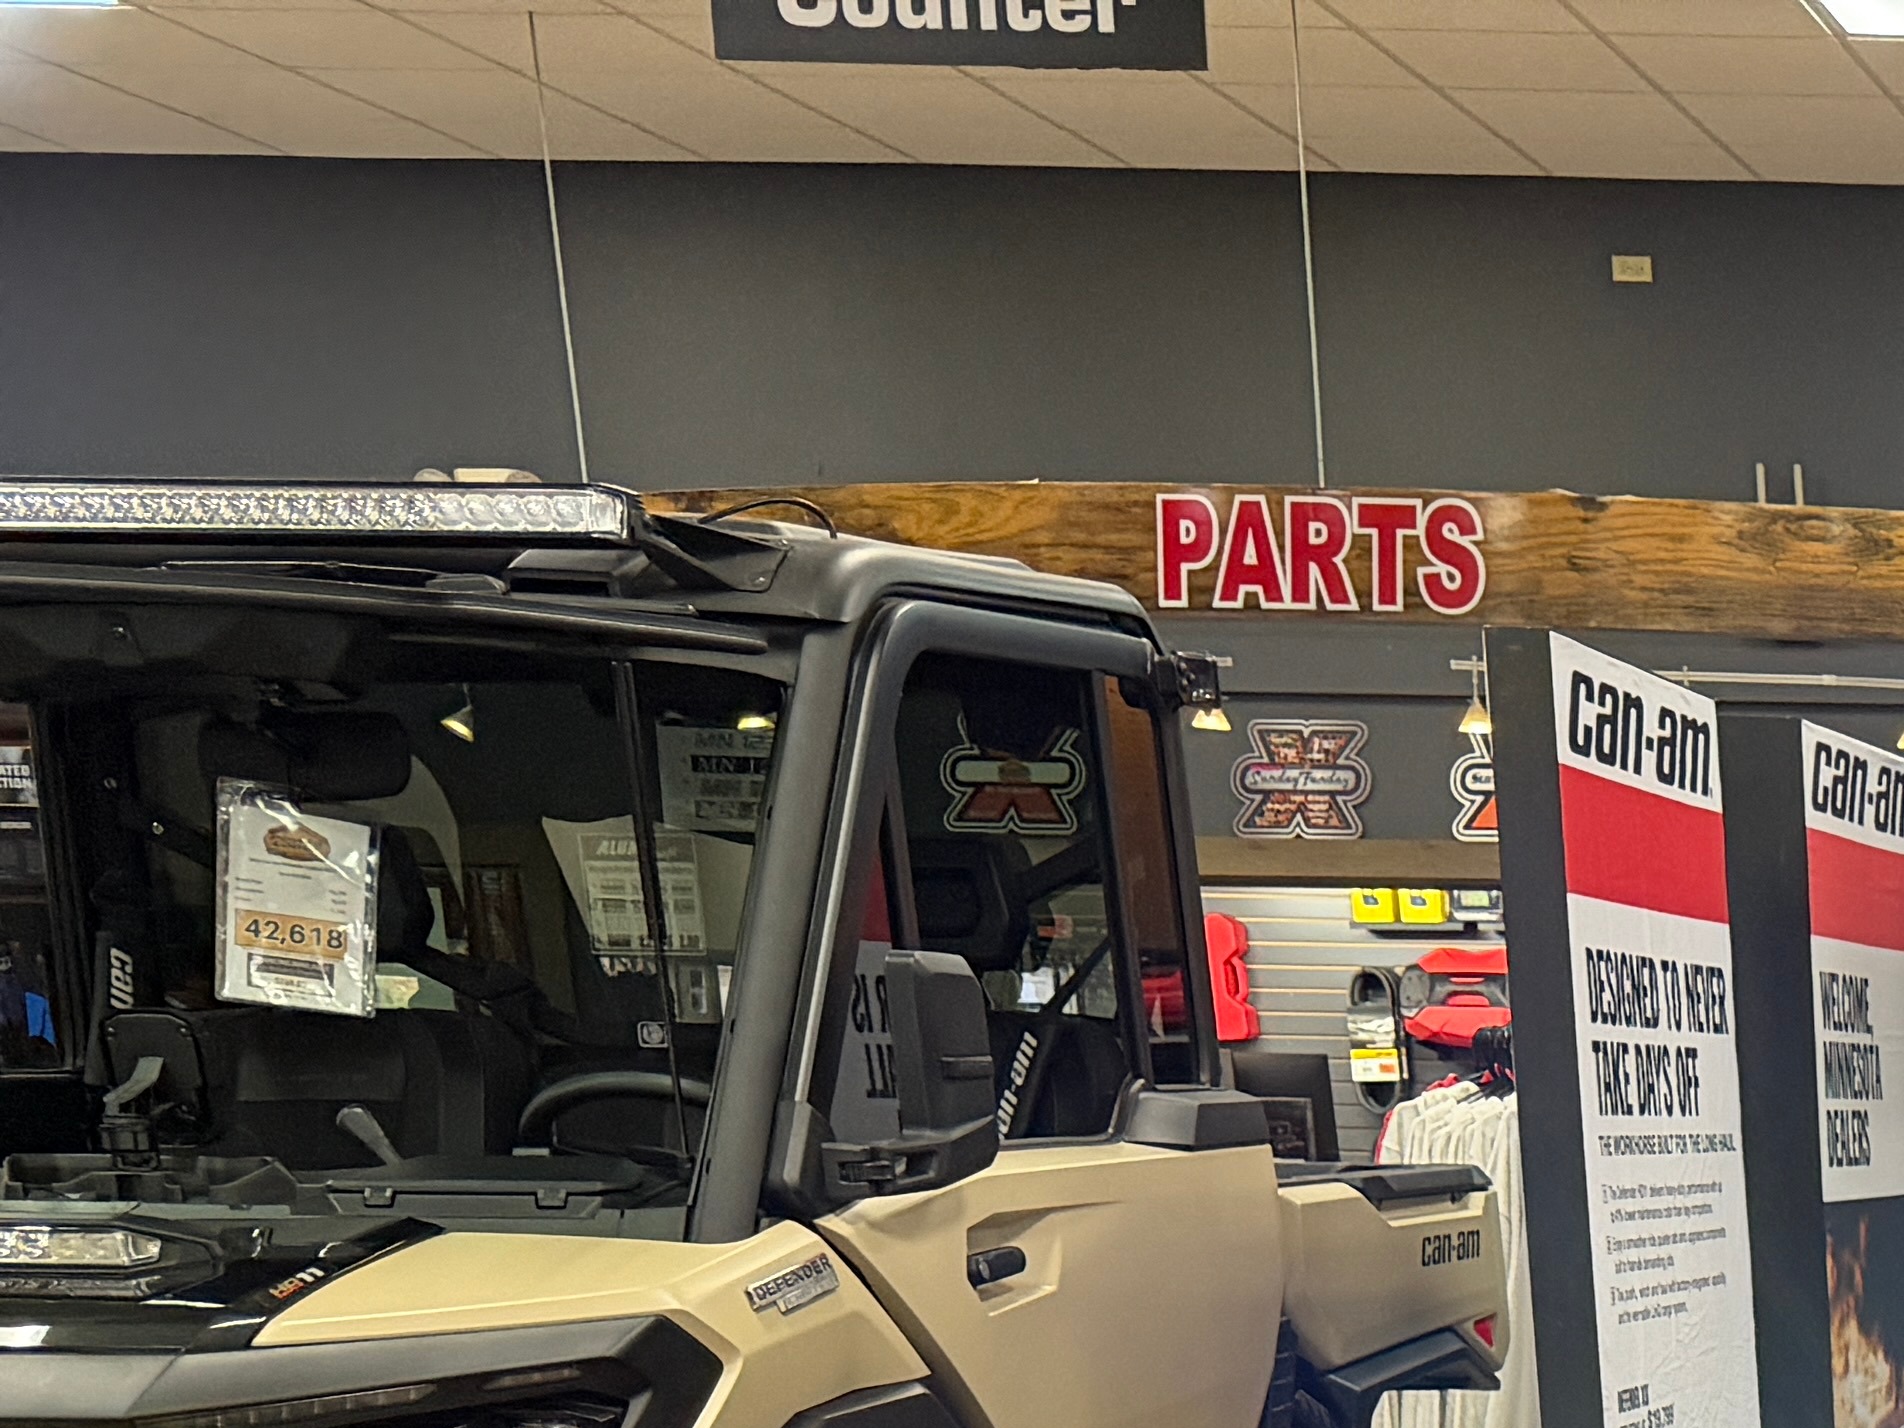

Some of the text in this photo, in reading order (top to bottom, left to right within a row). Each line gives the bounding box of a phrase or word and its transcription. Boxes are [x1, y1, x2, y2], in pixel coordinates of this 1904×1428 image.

[1155, 490, 1487, 615] PARTS
[244, 918, 344, 950] 42,618
[1585, 947, 1730, 1035] DESIGNED TO NEVER
[1591, 1040, 1700, 1118] TAKE DAYS OFF
[752, 1252, 832, 1301] DEFENDER
